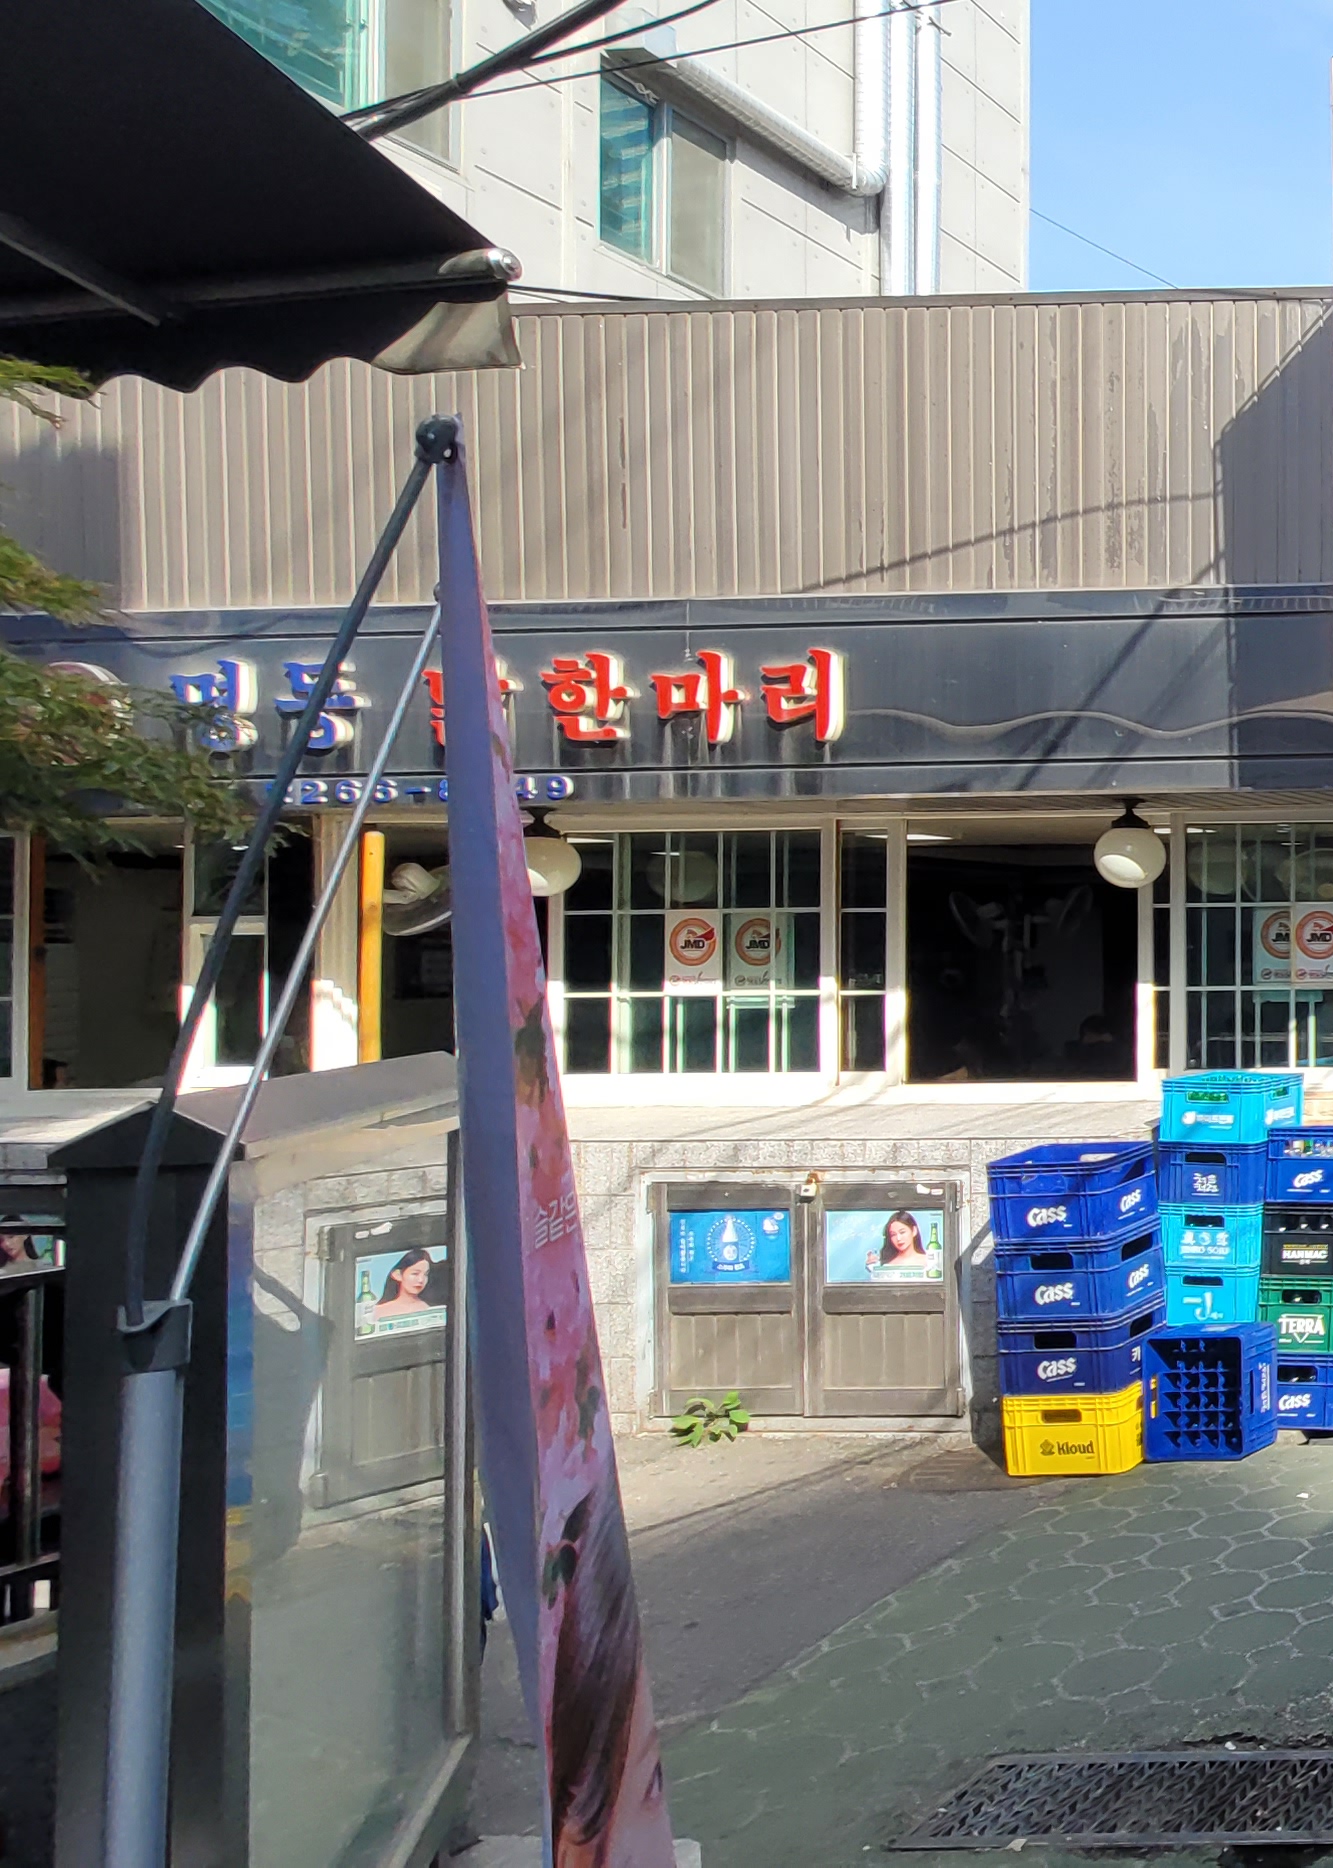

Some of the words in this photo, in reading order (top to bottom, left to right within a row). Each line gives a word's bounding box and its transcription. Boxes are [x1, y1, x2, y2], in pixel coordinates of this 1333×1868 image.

[169, 657, 372, 752] 명동
[1293, 1168, 1324, 1188] Cass
[1119, 1188, 1142, 1214] Cass
[1027, 1205, 1067, 1228] Cass
[1034, 1282, 1074, 1306] Cass
[1278, 1315, 1325, 1335] TERRA
[1037, 1356, 1077, 1381] Cass
[1278, 1393, 1311, 1411] Cass
[1057, 1438, 1095, 1456] Kloud
